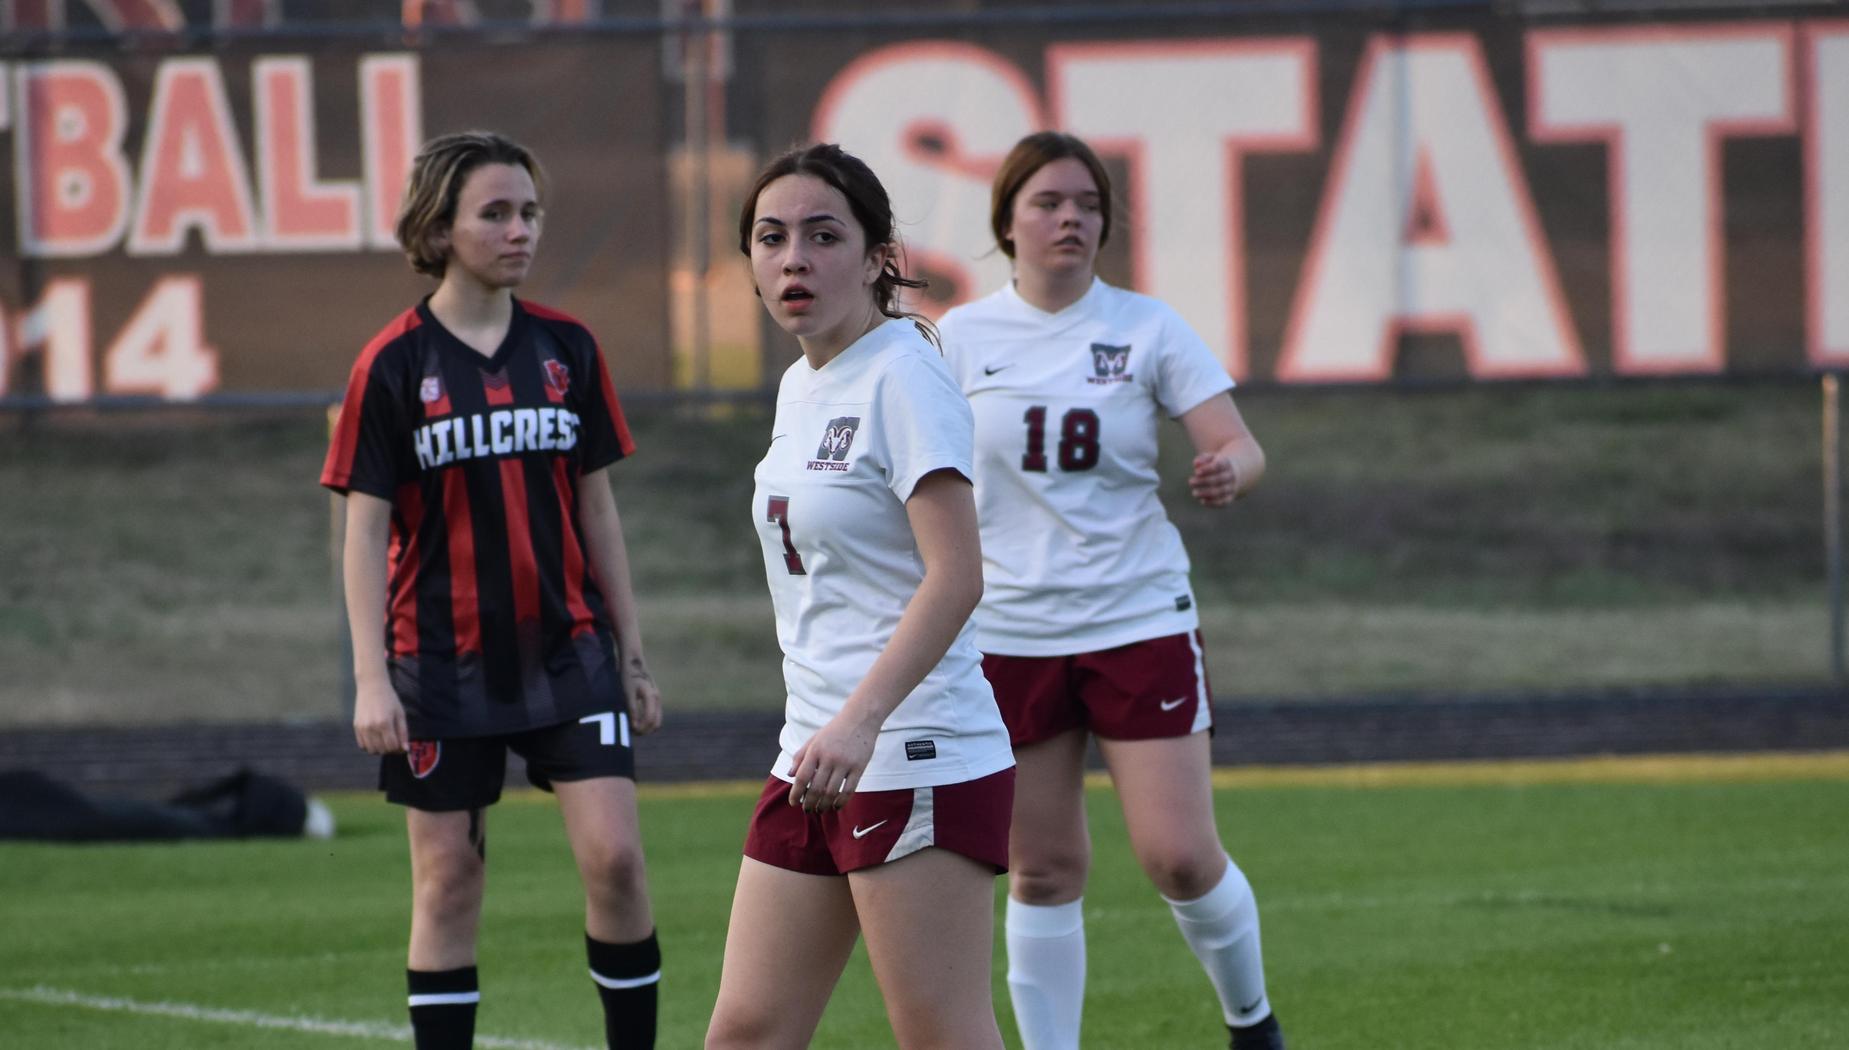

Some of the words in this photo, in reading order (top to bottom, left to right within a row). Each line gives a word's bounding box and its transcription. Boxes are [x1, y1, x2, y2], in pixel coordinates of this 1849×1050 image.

[0, 275, 221, 402] 14
[806, 460, 851, 472] WESTSIDE
[1021, 405, 1101, 474] 18
[766, 495, 808, 576] 7
